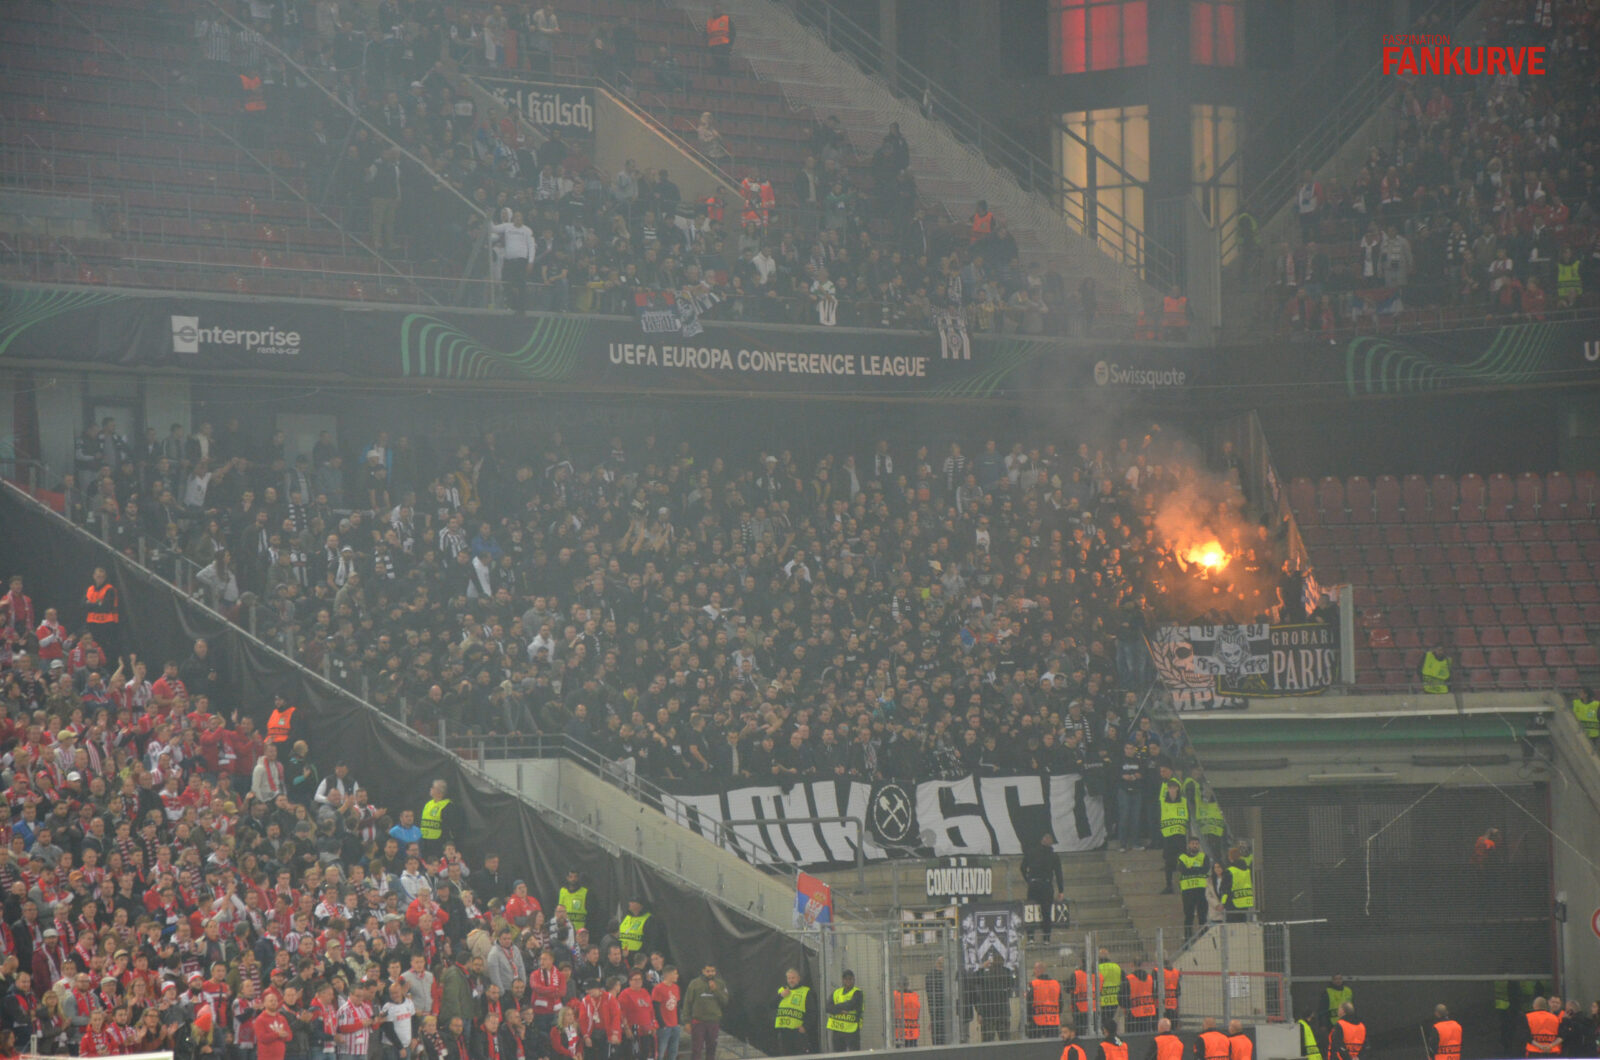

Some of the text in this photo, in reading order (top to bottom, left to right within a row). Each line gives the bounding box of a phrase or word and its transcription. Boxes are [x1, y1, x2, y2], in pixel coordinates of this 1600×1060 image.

[173, 322, 300, 351] enterprise
[609, 343, 926, 377] UEFA EUROPA CONFERENCE LEAGUE
[1110, 363, 1186, 390] Swissquote
[1272, 648, 1335, 690] PARIS
[926, 867, 993, 897] COMMANDO
